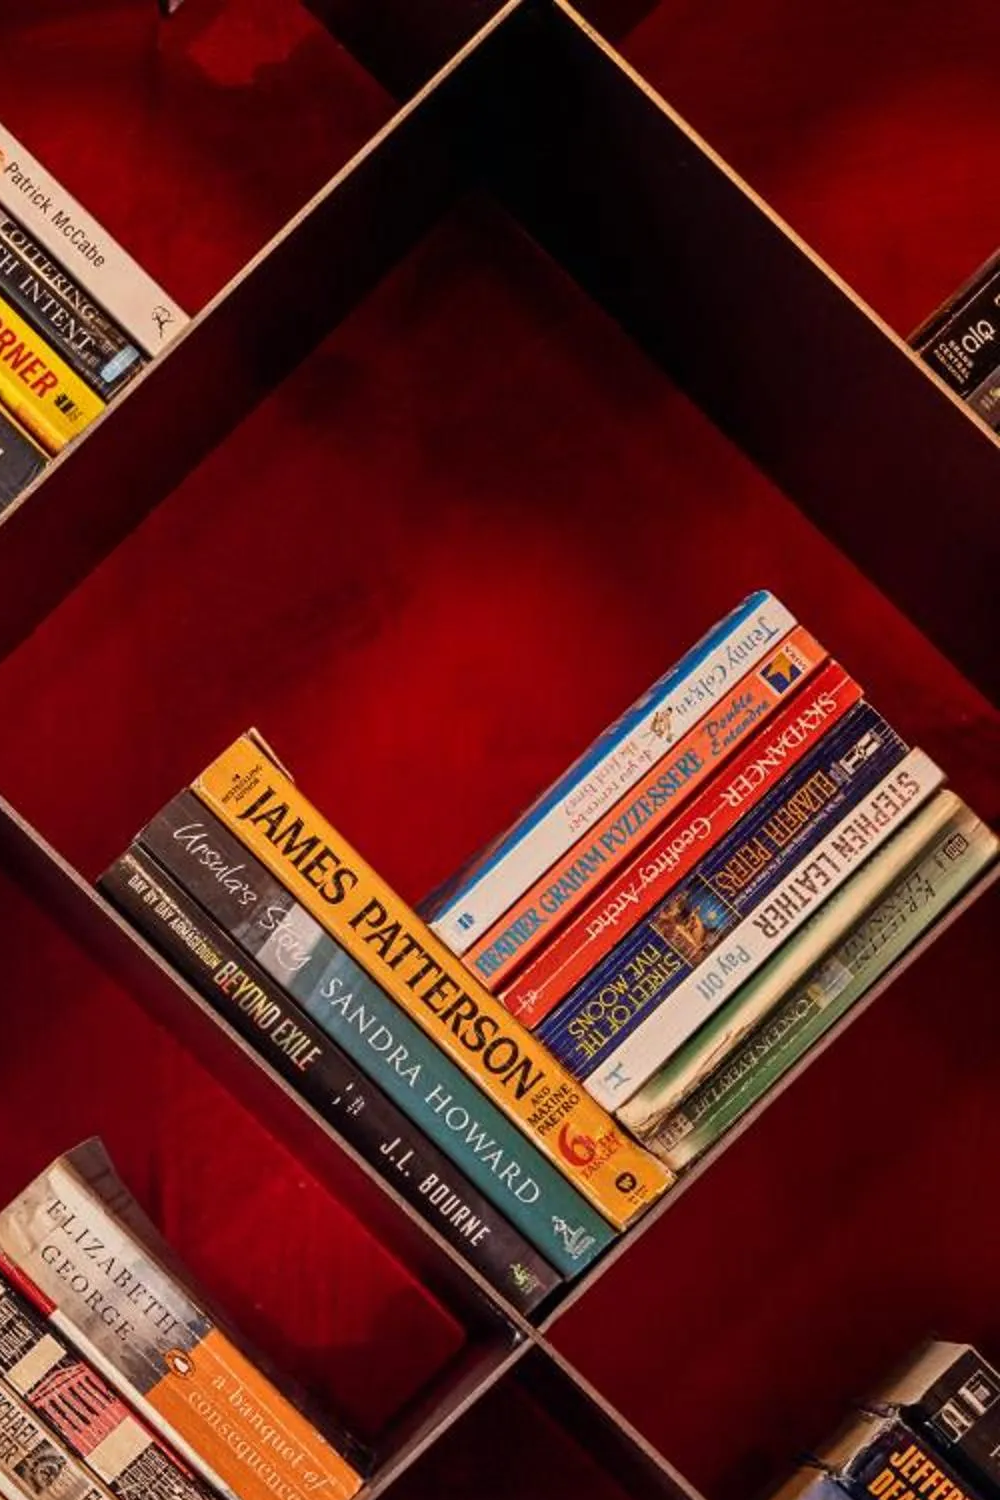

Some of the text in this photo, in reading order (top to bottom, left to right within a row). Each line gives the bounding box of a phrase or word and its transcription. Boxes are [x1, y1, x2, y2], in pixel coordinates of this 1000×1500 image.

[3, 161, 106, 267] Patrick McCabe
[18, 274, 96, 355] INTENT
[938, 343, 970, 377] CENTRAL
[720, 692, 837, 807] SKYDANCER
[638, 816, 713, 888] Geoffrey
[762, 773, 838, 846] ELIZABETH
[830, 771, 921, 862] STEPHEN
[472, 903, 547, 977] HEATHER
[538, 845, 607, 914] GRAHAM
[599, 750, 703, 853] POZZESSERE
[713, 839, 772, 895] PETERS
[755, 856, 839, 939] LEATHER
[239, 787, 543, 1099] JAMES PATTERSON
[585, 883, 642, 940] Archer
[126, 875, 321, 1070] DAY BY DAY ARMAGEDDON BEYOND EXILE
[695, 944, 750, 998] Pay Off
[320, 976, 541, 1204] SANDRA HOWARD
[526, 1082, 571, 1126] MAXINE
[537, 1093, 580, 1136] PAETRO
[379, 1136, 489, 1246] J.L. BOURNE
[40, 1244, 135, 1341] GEORGE
[46, 1199, 180, 1335] ELIZABETH
[212, 1375, 336, 1495] a banquet of
